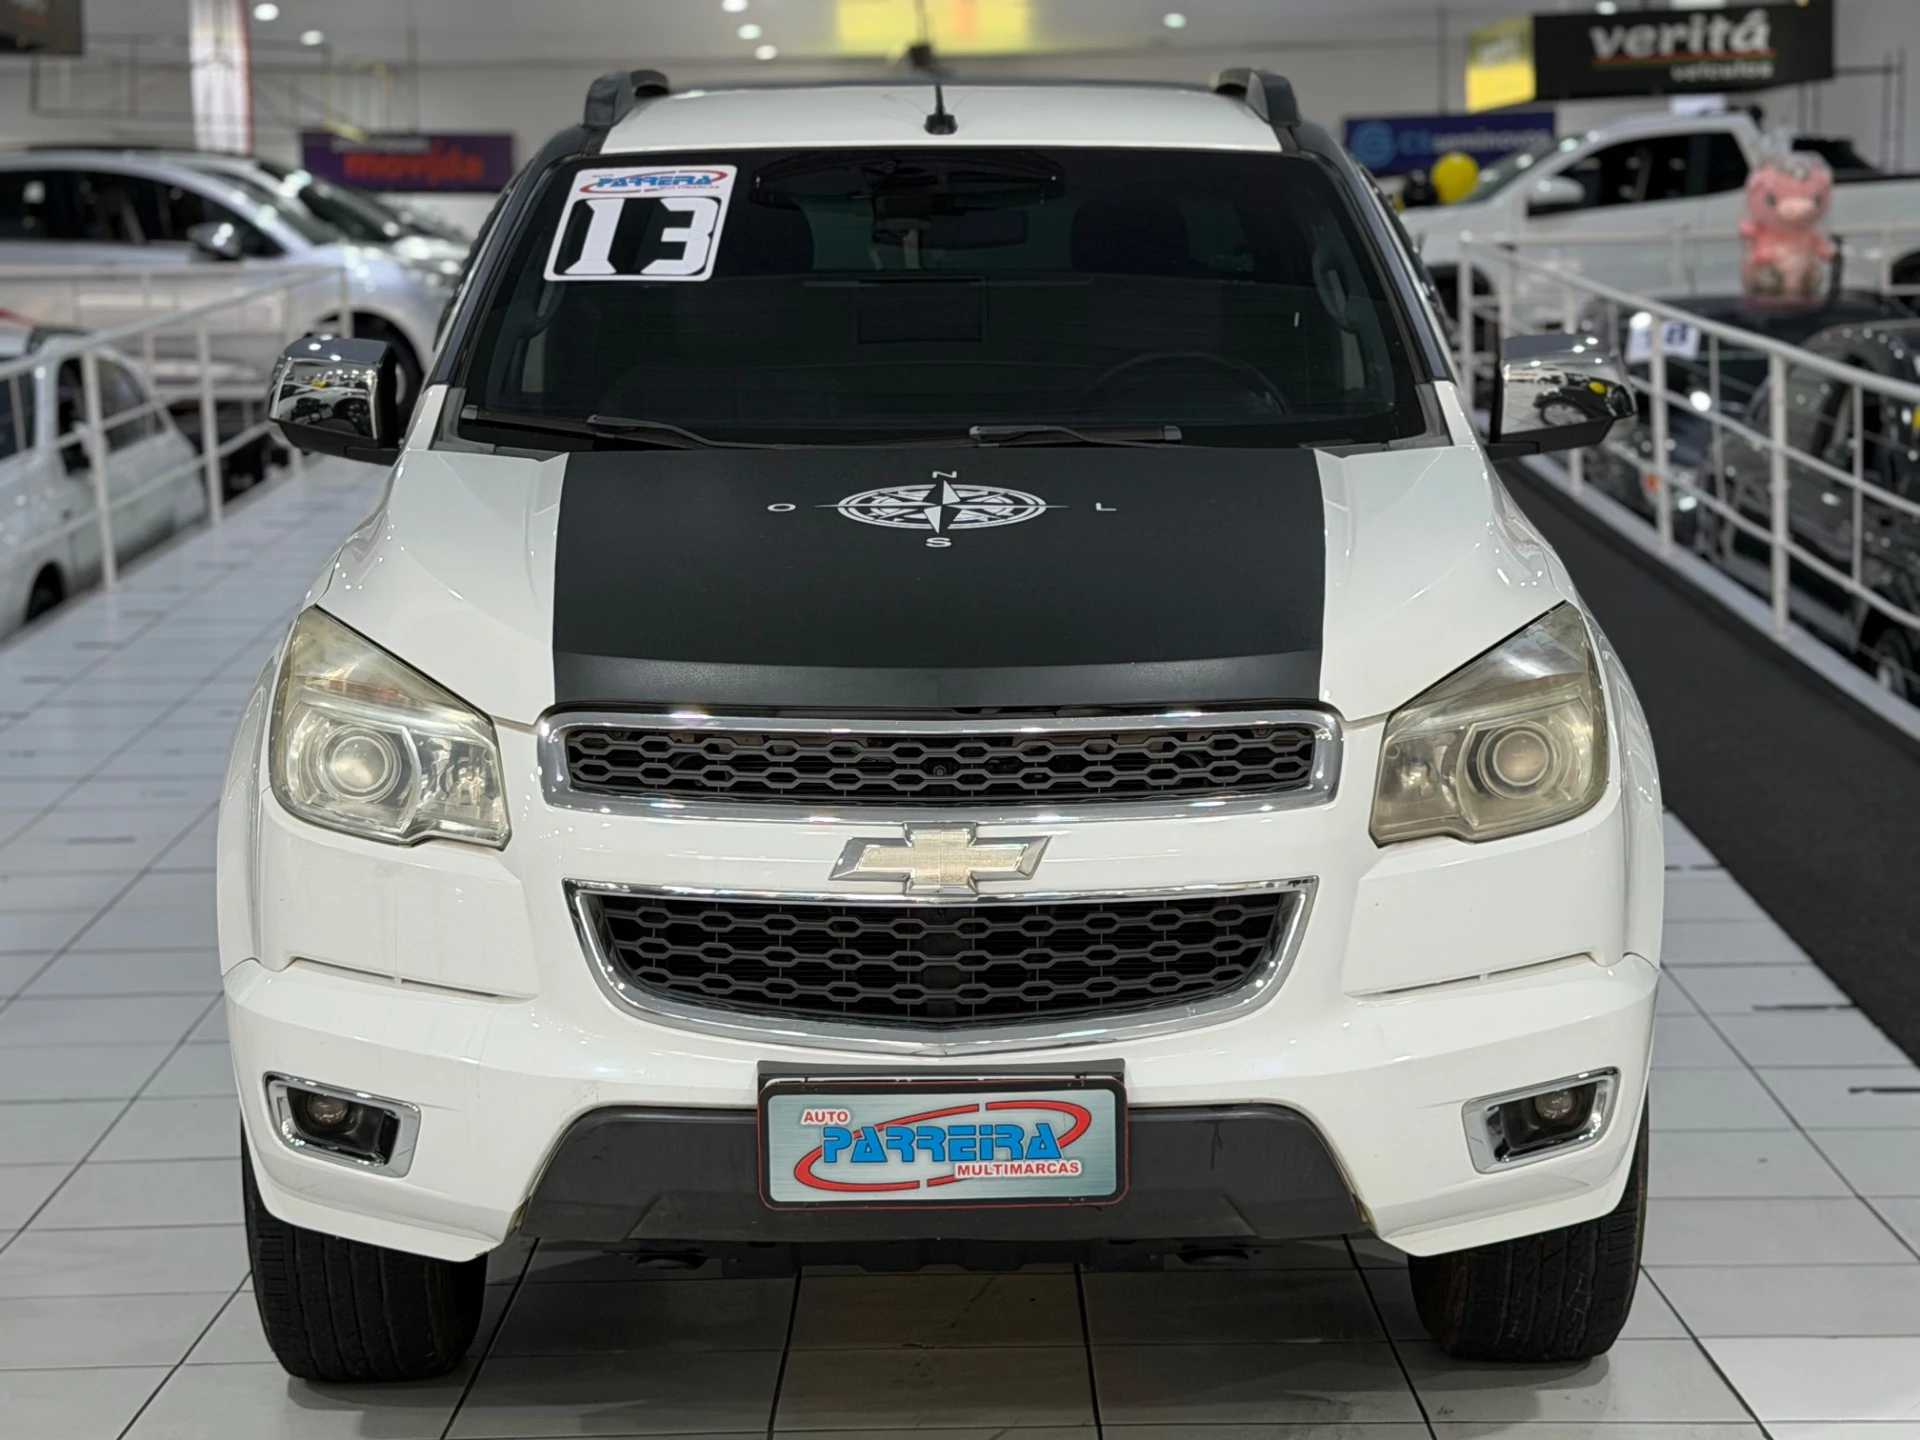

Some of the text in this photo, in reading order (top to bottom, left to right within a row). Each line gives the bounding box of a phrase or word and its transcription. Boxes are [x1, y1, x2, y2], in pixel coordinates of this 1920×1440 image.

[564, 198, 720, 275] 13
[925, 537, 952, 548] S
[802, 1110, 849, 1124] AUTO
[821, 1122, 1063, 1164] PARREIRA
[956, 1160, 1080, 1177] MULTIMARCAS
